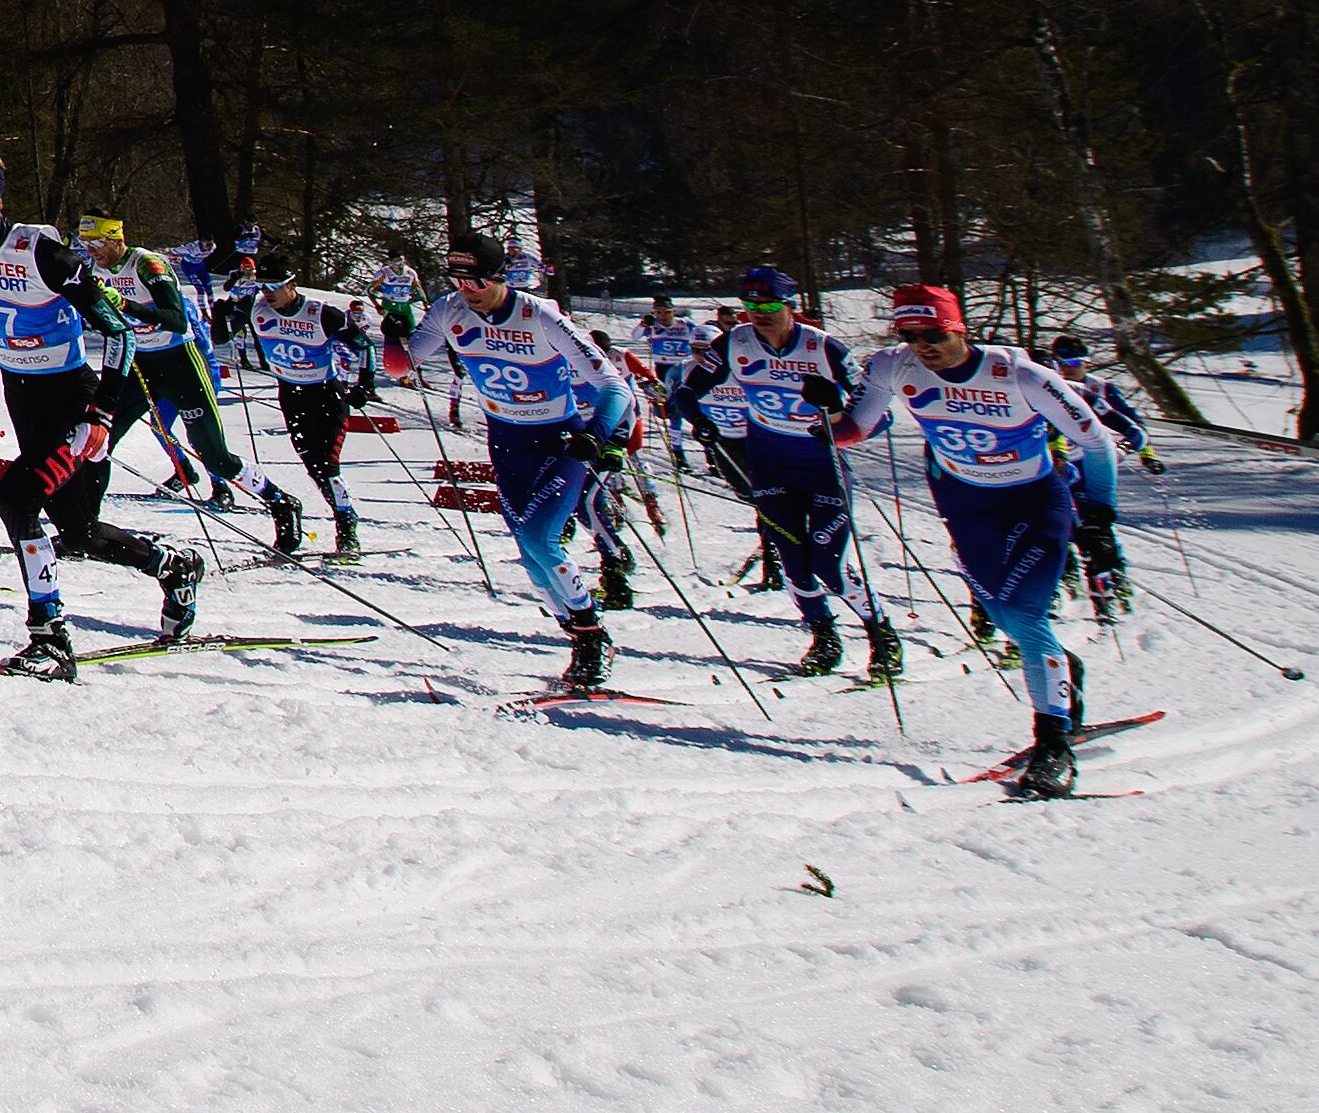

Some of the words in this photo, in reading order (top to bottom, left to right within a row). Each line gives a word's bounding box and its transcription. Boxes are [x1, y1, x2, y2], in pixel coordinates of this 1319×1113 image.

[278, 326, 316, 339] SPORT
[279, 318, 314, 331] INTER
[484, 326, 535, 344] INTER
[272, 342, 306, 361] 40
[485, 339, 536, 356] SPORT
[662, 340, 684, 352] 57
[769, 357, 818, 373] INTER
[478, 363, 530, 392] 29
[769, 369, 804, 383] SPO
[756, 390, 804, 411] 37
[944, 386, 1010, 405] INTER
[709, 407, 744, 422] 55
[945, 400, 1012, 418] SPORT
[935, 425, 998, 453] 39
[34, 444, 86, 496] JAP
[998, 545, 1048, 601] RAIFFEISEN
[166, 642, 227, 654] FISCHER
